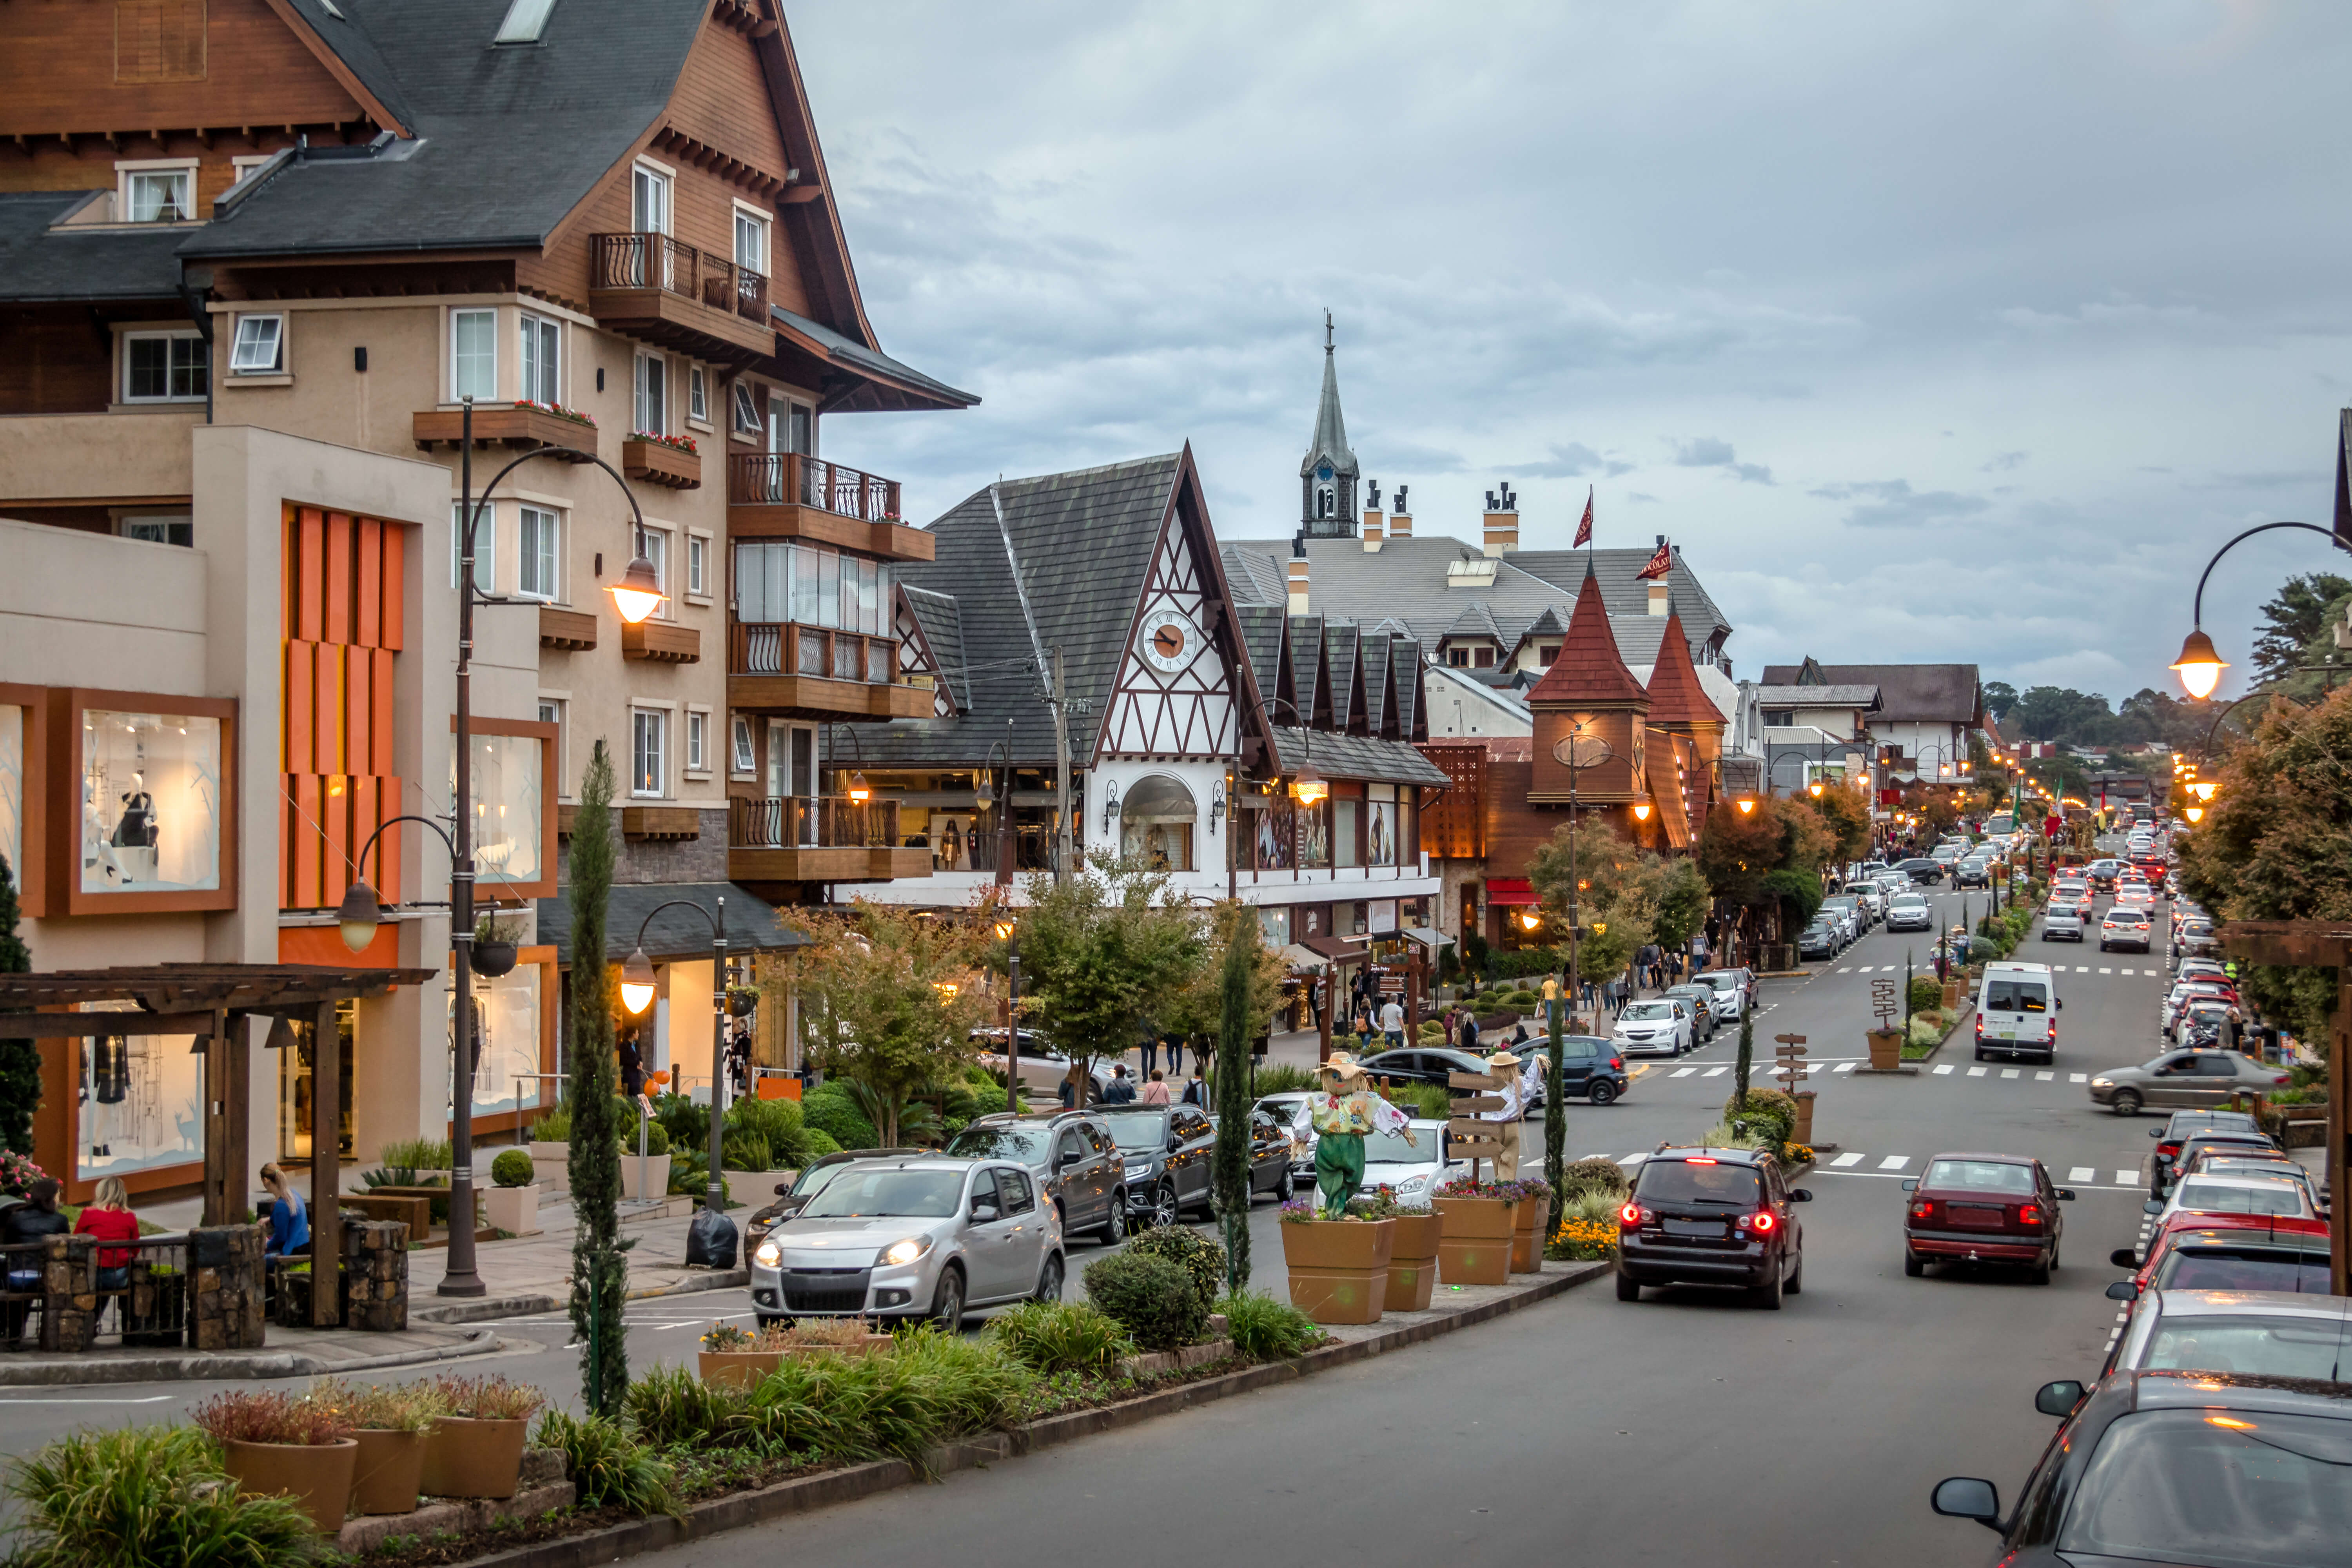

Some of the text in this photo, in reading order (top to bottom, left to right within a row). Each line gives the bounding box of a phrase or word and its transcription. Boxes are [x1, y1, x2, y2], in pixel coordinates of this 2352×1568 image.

[1155, 615, 1162, 625] XI
[1147, 646, 1156, 658] VIII
[1183, 650, 1190, 659] IV
[1167, 661, 1172, 670] VI
[1176, 658, 1181, 666] V
